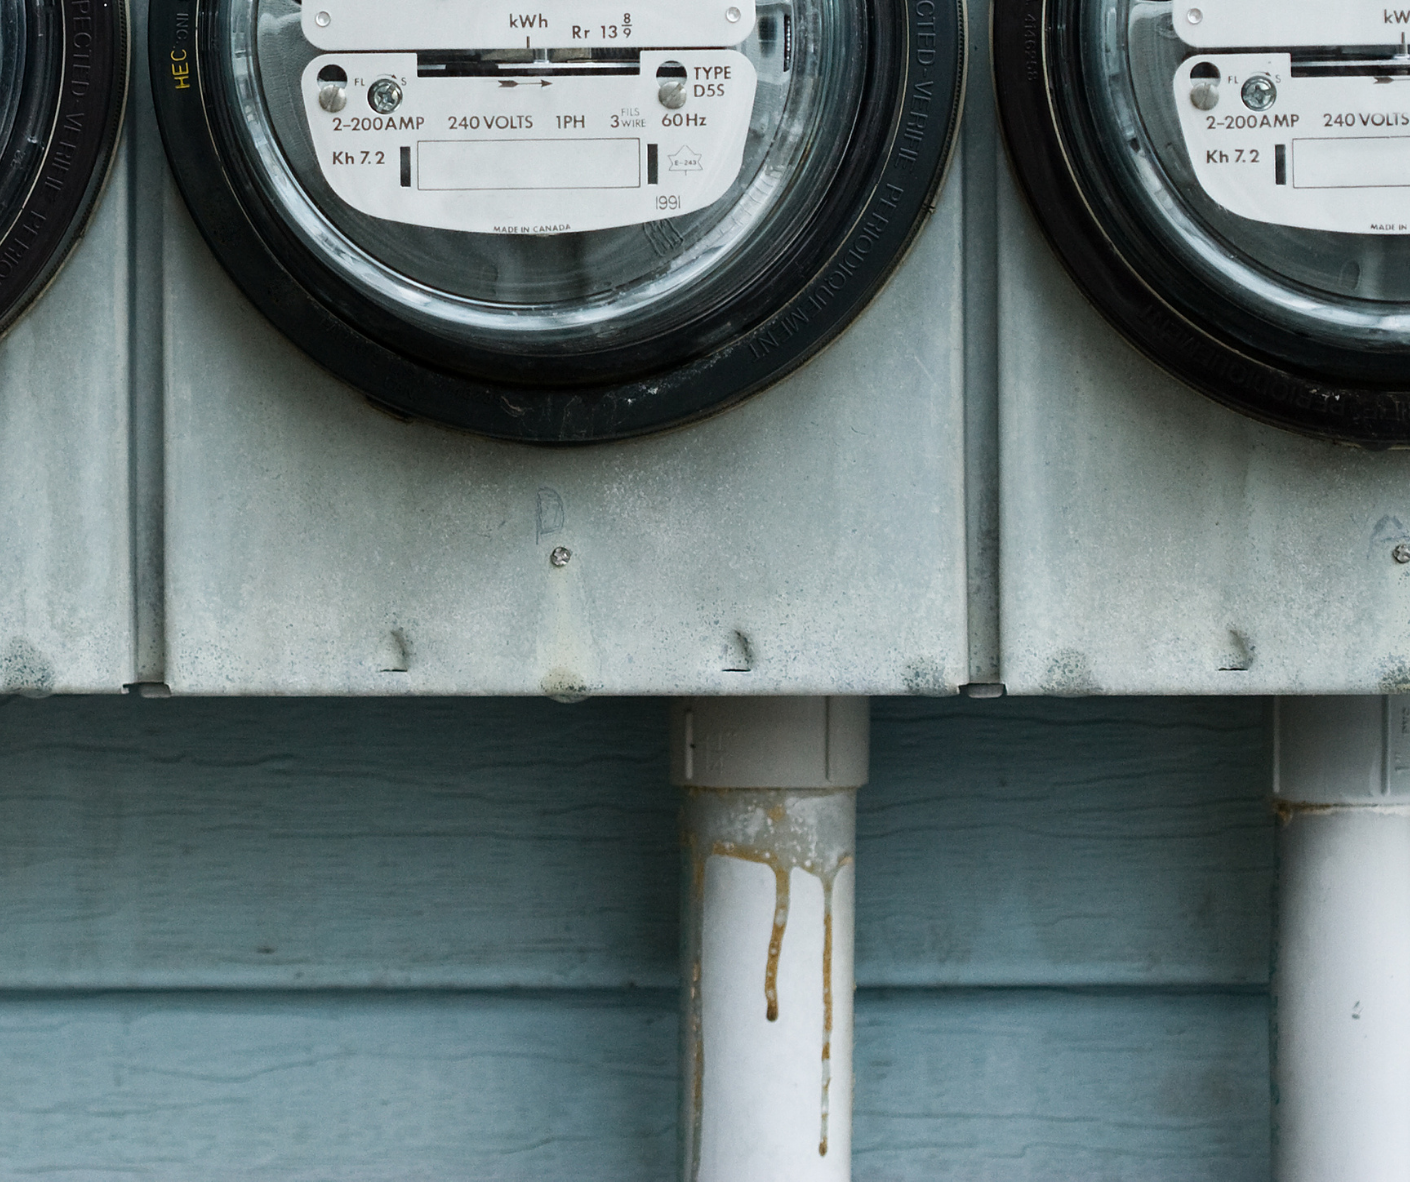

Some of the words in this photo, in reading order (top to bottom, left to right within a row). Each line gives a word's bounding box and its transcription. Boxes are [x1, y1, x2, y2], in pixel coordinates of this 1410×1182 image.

[509, 12, 549, 29] kWh
[571, 25, 591, 39] Rr
[600, 24, 618, 39] 13
[170, 48, 191, 91] HEC
[693, 65, 732, 81] TYPE
[693, 83, 725, 98] D5S
[621, 118, 646, 128] WIRE
[492, 225, 519, 234] MADE
[519, 225, 531, 233] IN
[532, 223, 571, 233] CANADA
[1370, 223, 1395, 231] MADE
